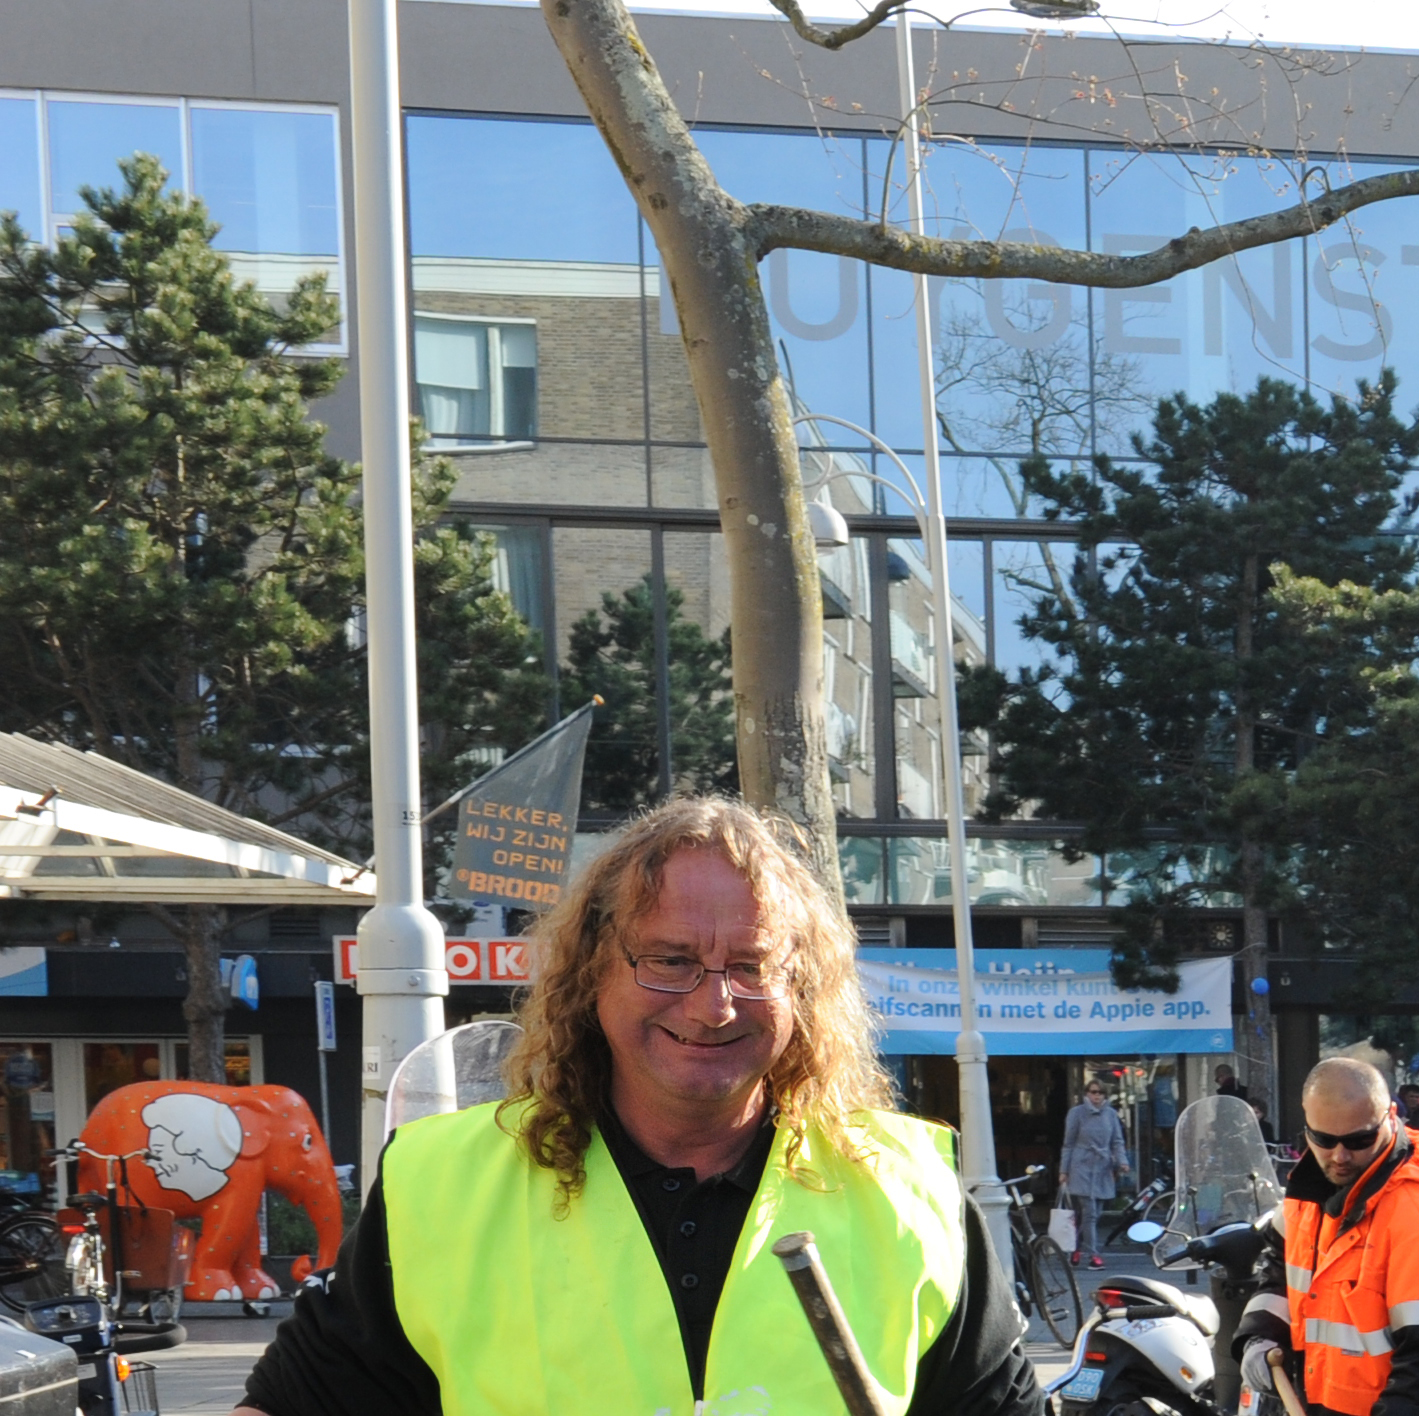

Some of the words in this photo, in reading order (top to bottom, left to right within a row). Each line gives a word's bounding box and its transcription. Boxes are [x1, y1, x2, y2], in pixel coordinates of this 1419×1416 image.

[466, 800, 570, 832] LEKKER,
[466, 822, 506, 842] WIJ
[512, 829, 567, 852] ZIJN
[492, 849, 564, 874] OPEN!
[888, 975, 910, 993] In
[918, 980, 961, 995] onz
[982, 978, 1059, 996] winkel
[1000, 1001, 1046, 1019] met
[1053, 1000, 1081, 1019] de
[1089, 998, 1155, 1021] Appie
[1163, 1001, 1211, 1020] app.
